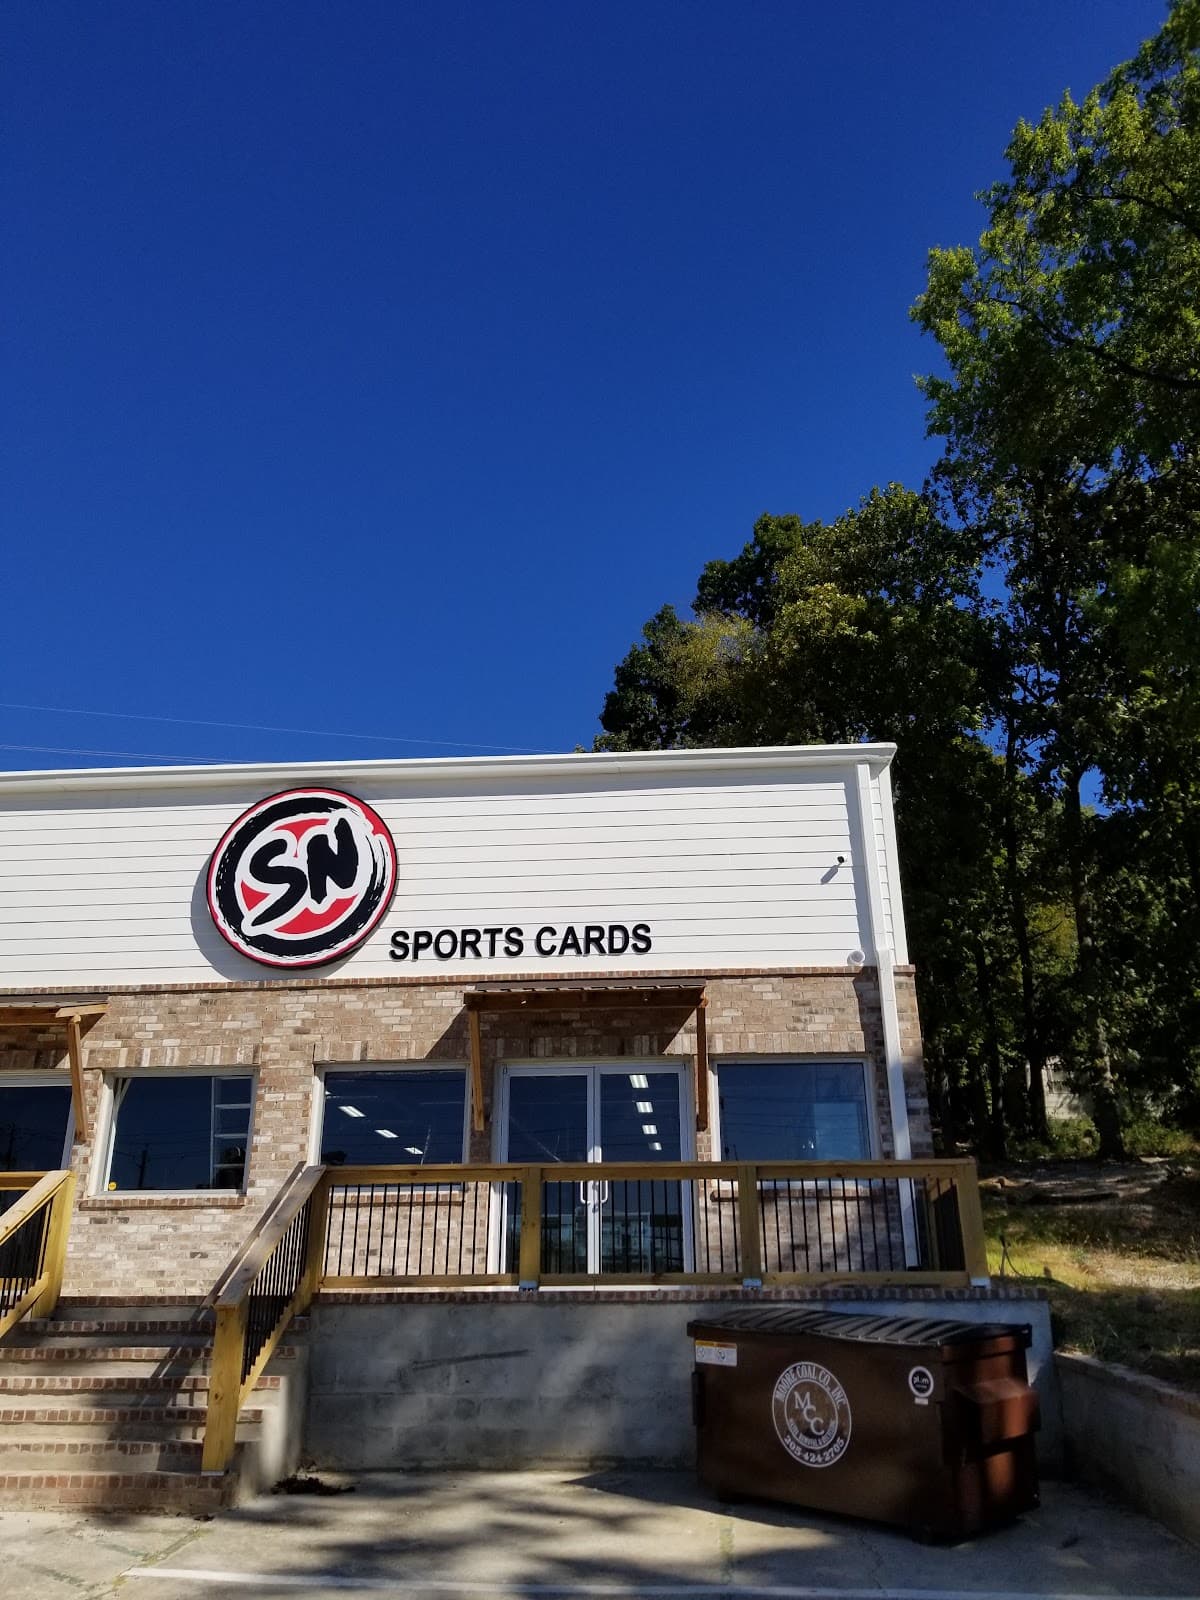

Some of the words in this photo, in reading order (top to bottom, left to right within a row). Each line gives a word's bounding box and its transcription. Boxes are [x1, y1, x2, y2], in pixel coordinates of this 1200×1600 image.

[249, 816, 359, 926] SN
[390, 927, 523, 960] SPORTS
[536, 923, 652, 957] CARDS
[775, 1368, 798, 1402] MOORE
[796, 1364, 817, 1379] COAL
